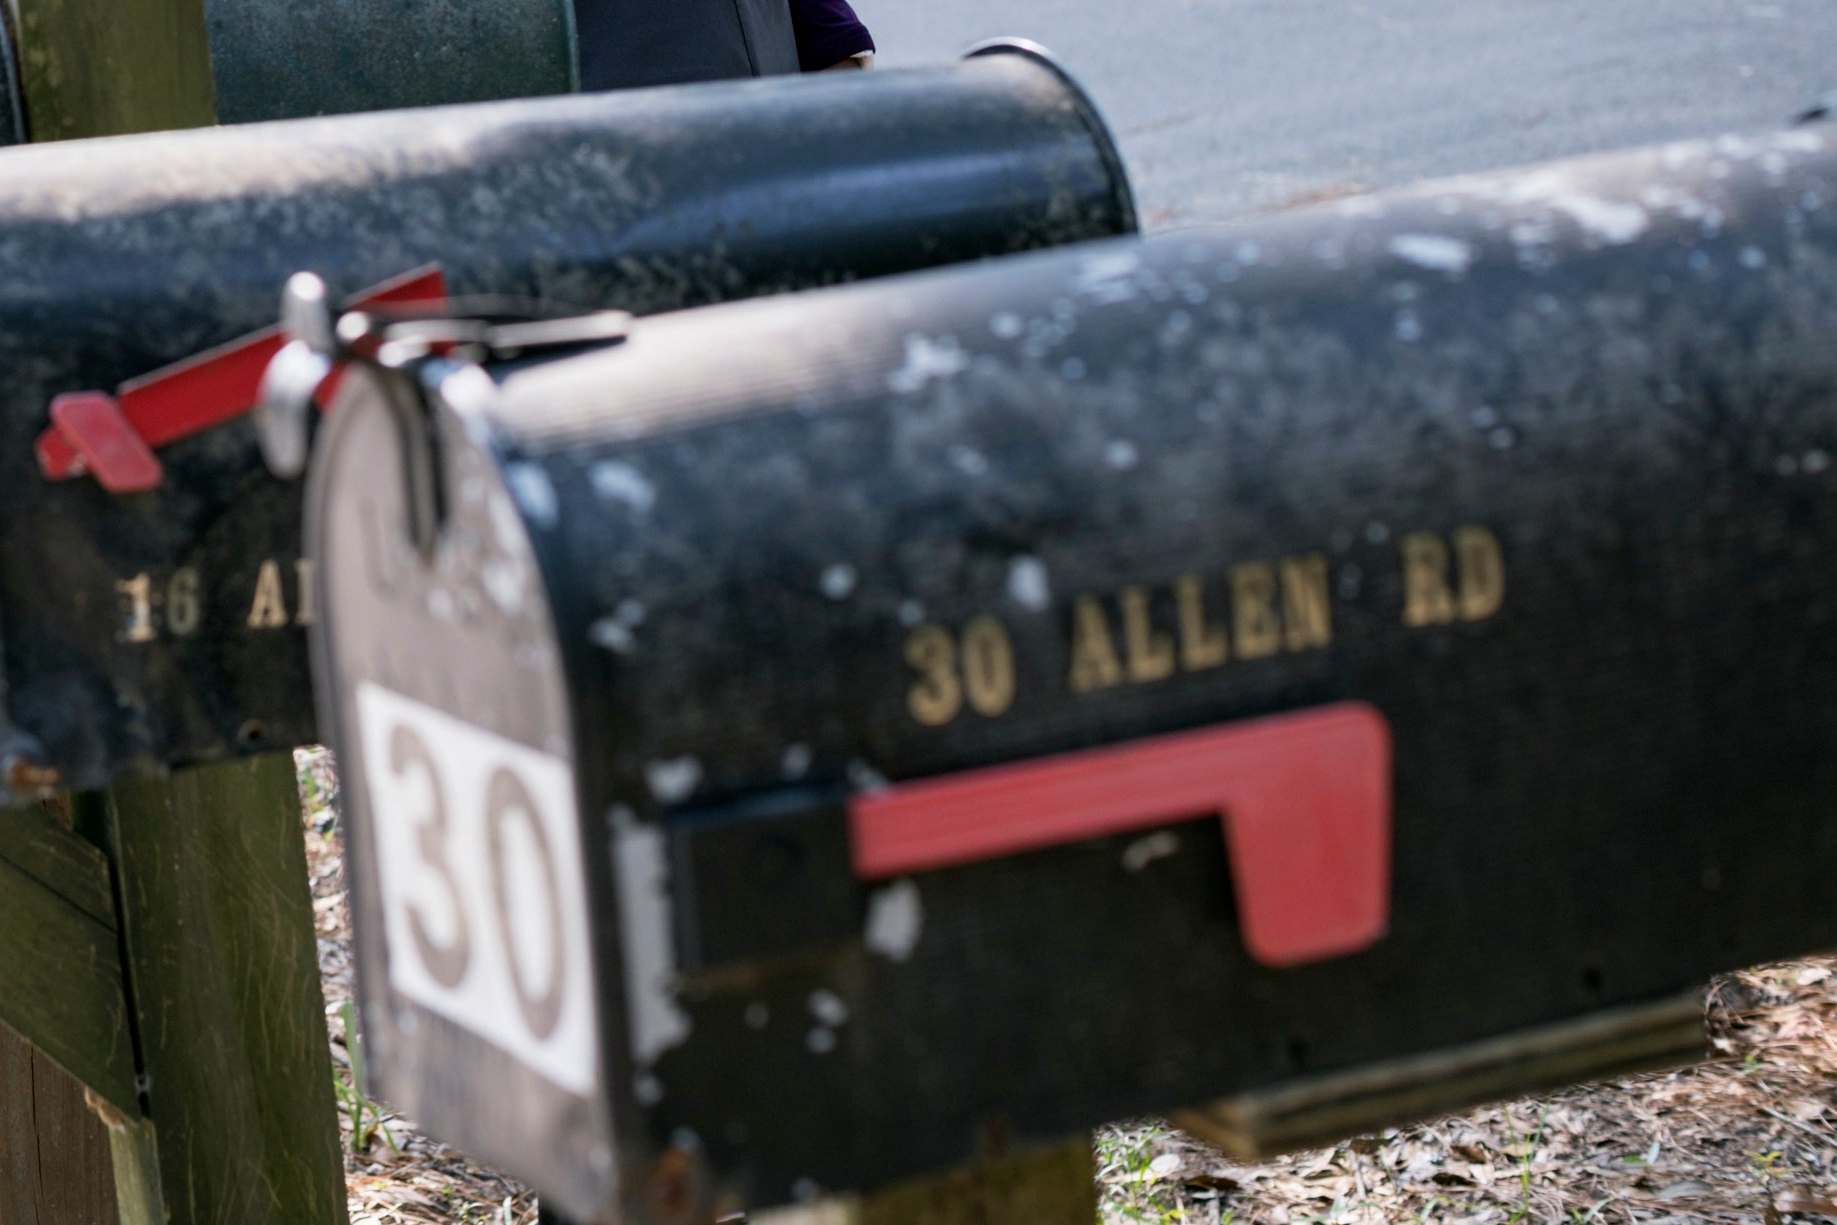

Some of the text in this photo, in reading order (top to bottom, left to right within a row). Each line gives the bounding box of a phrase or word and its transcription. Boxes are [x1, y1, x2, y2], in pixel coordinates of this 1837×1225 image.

[115, 566, 200, 642] 16
[901, 524, 1505, 726] 30 ALLEN RD
[390, 722, 567, 1041] 30
